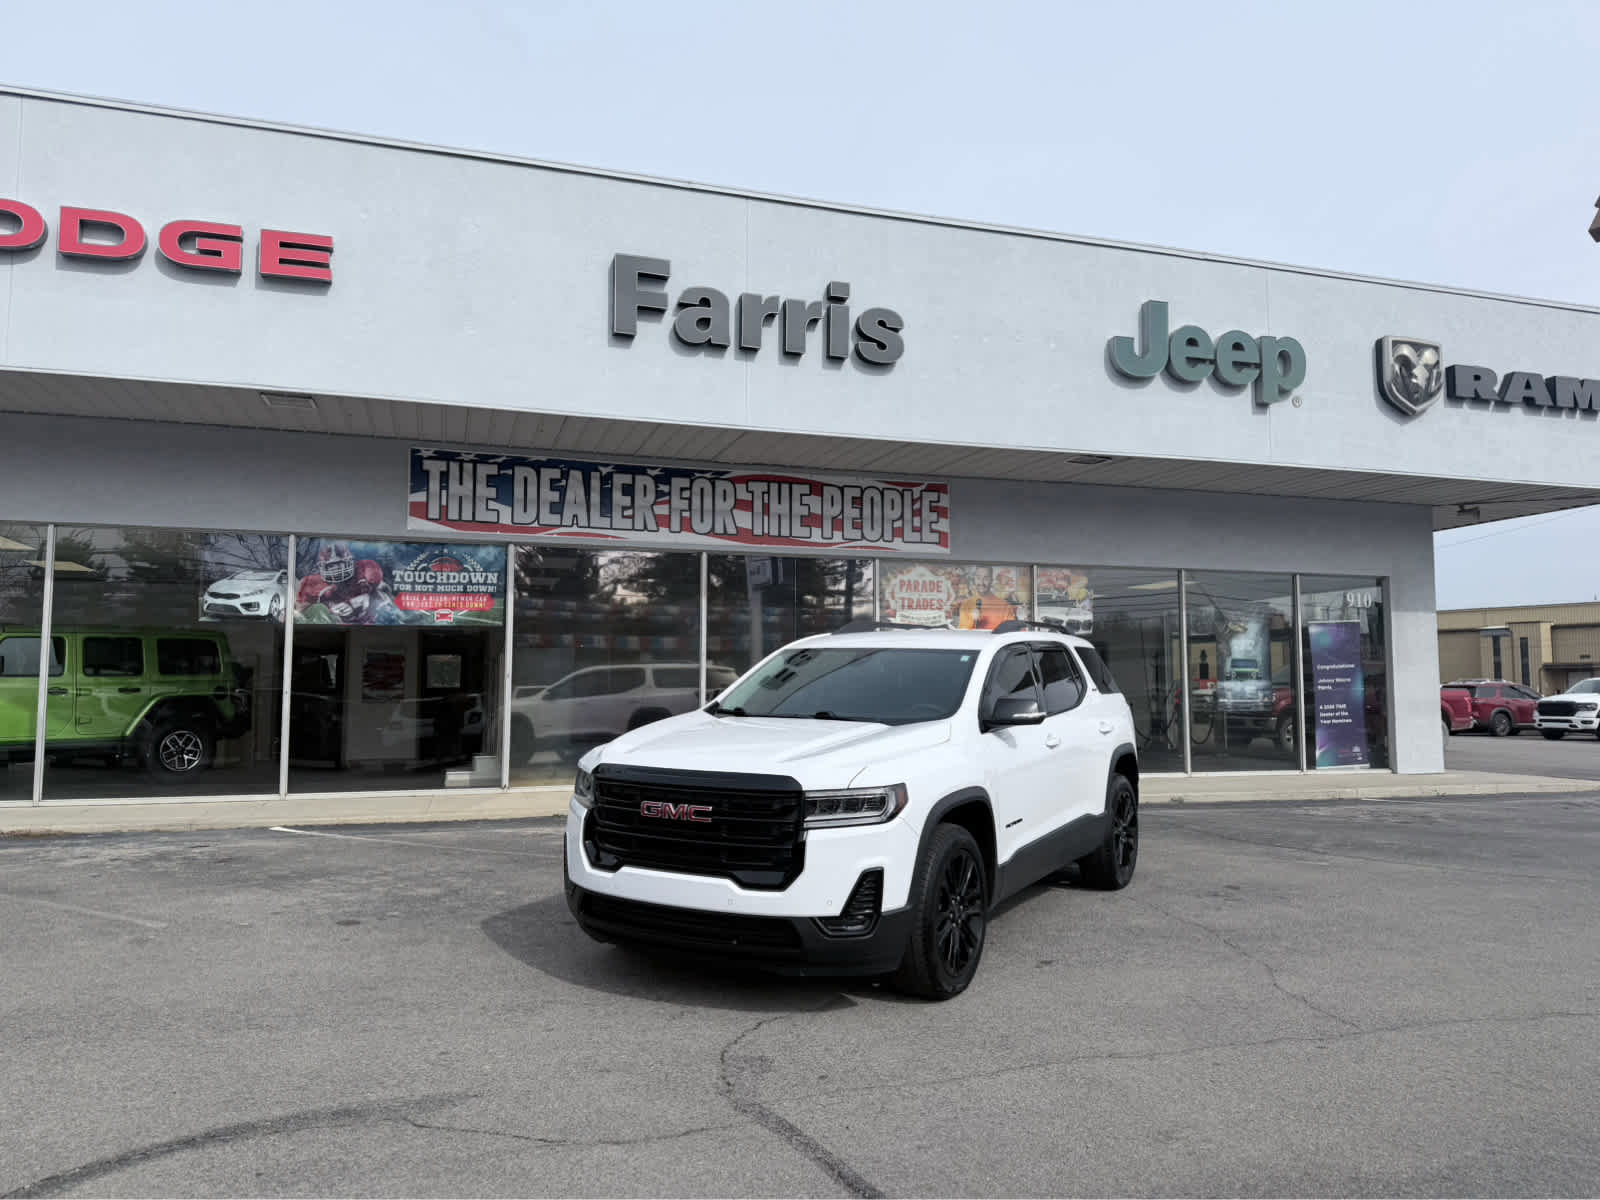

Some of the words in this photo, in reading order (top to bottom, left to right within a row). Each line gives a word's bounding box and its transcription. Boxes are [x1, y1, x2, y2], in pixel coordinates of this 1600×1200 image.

[611, 252, 905, 364] Farris
[1105, 299, 1307, 406] Jeep
[1446, 364, 1600, 411] RAM
[422, 458, 500, 524] THE
[511, 464, 660, 533] DEALER
[669, 475, 739, 537] FOR
[746, 480, 812, 539] THE
[820, 484, 942, 545] PEOPLE
[392, 569, 498, 584] TOUCHDOWN
[899, 579, 943, 593] PARADE
[393, 583, 412, 591] FOR
[415, 584, 434, 592] NOT
[437, 584, 464, 592] MUCH
[467, 585, 497, 593] DOWN!
[900, 597, 945, 611] TRADES
[1345, 591, 1372, 608] 910
[641, 801, 712, 822] GMC
